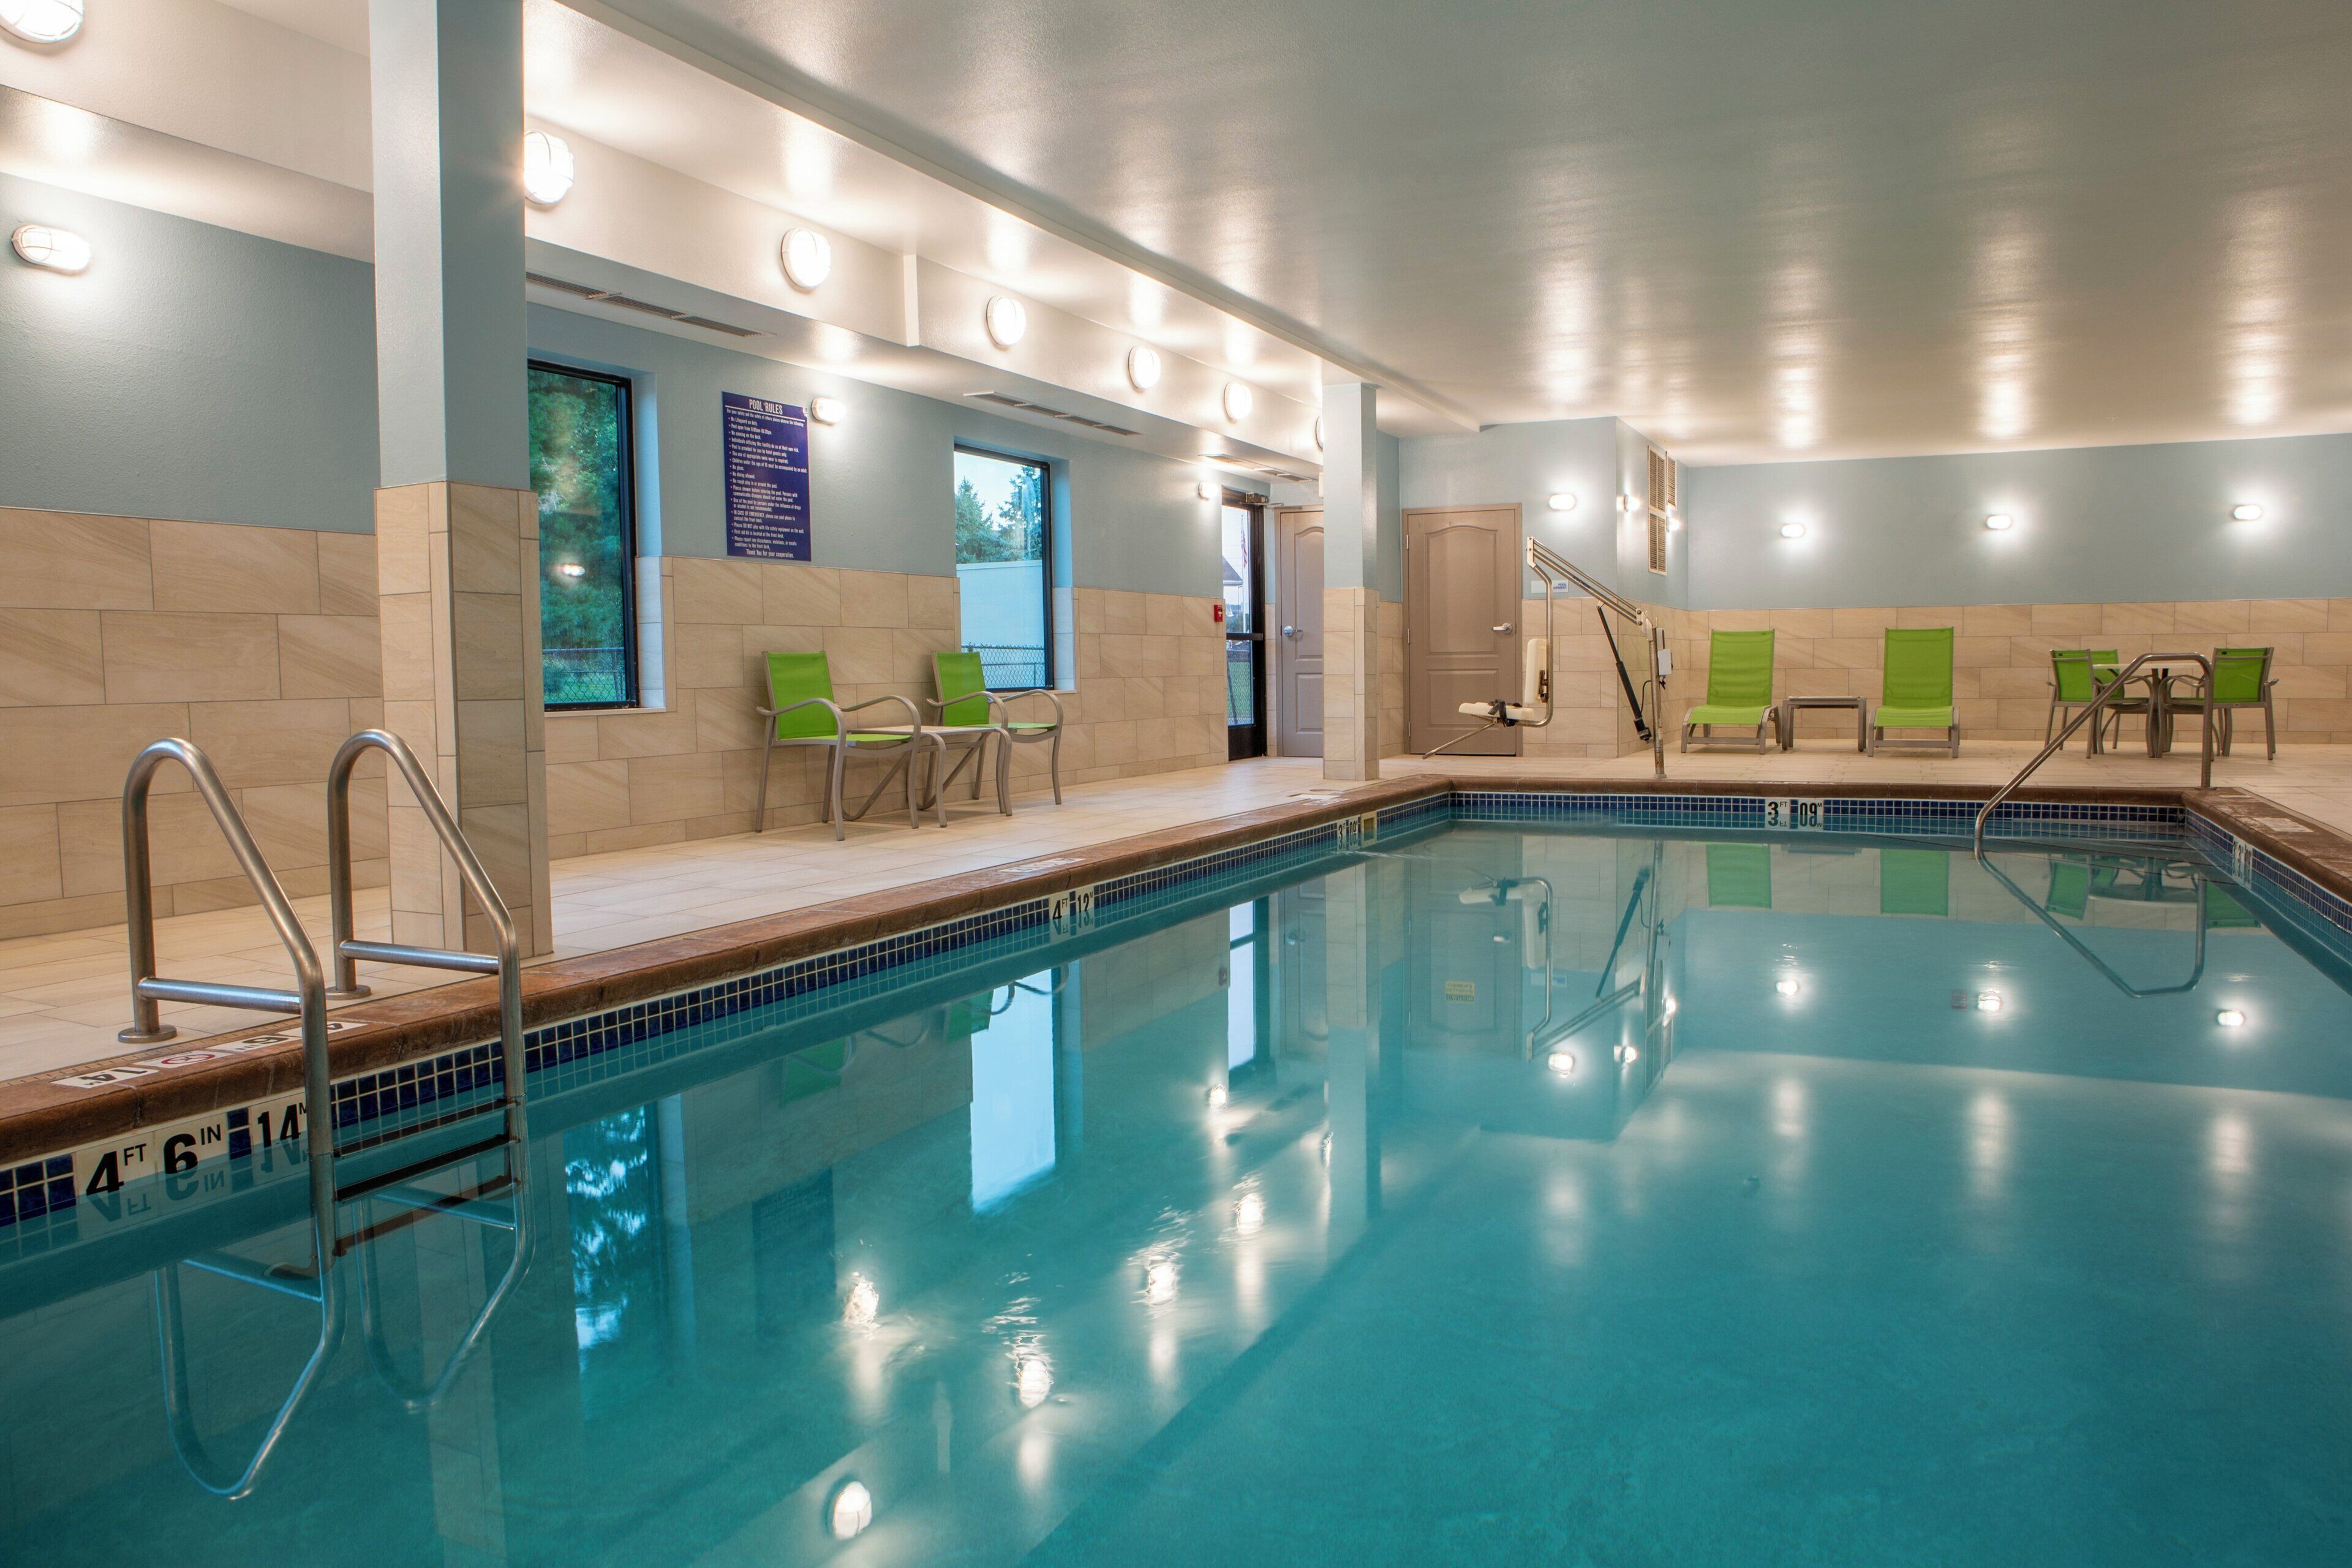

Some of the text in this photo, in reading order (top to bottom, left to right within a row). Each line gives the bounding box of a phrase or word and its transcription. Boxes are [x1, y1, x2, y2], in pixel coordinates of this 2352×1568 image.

[749, 399, 783, 415] POOL RULES
[1768, 801, 1779, 815] 3
[1052, 897, 1068, 920] 4 FT
[86, 1123, 222, 1196] 4 FT 6 IN
